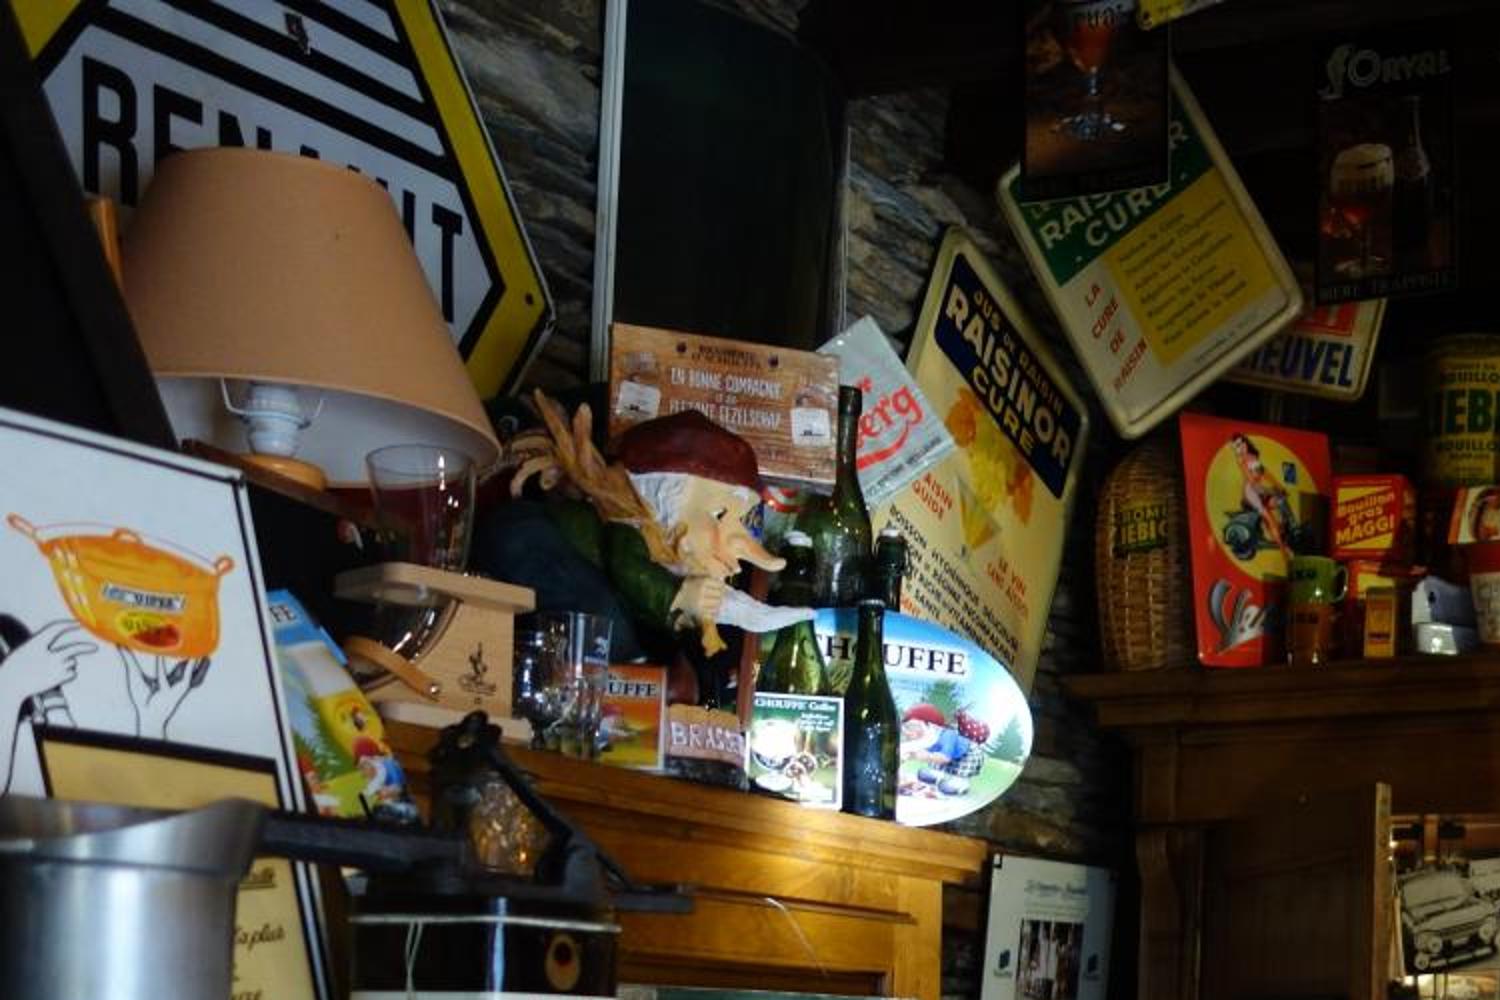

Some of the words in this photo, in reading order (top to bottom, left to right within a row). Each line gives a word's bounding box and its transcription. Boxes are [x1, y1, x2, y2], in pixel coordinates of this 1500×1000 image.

[946, 285, 1072, 468] RAISINOR
[972, 368, 1034, 455] CURE
[1335, 513, 1394, 545] MAGGI
